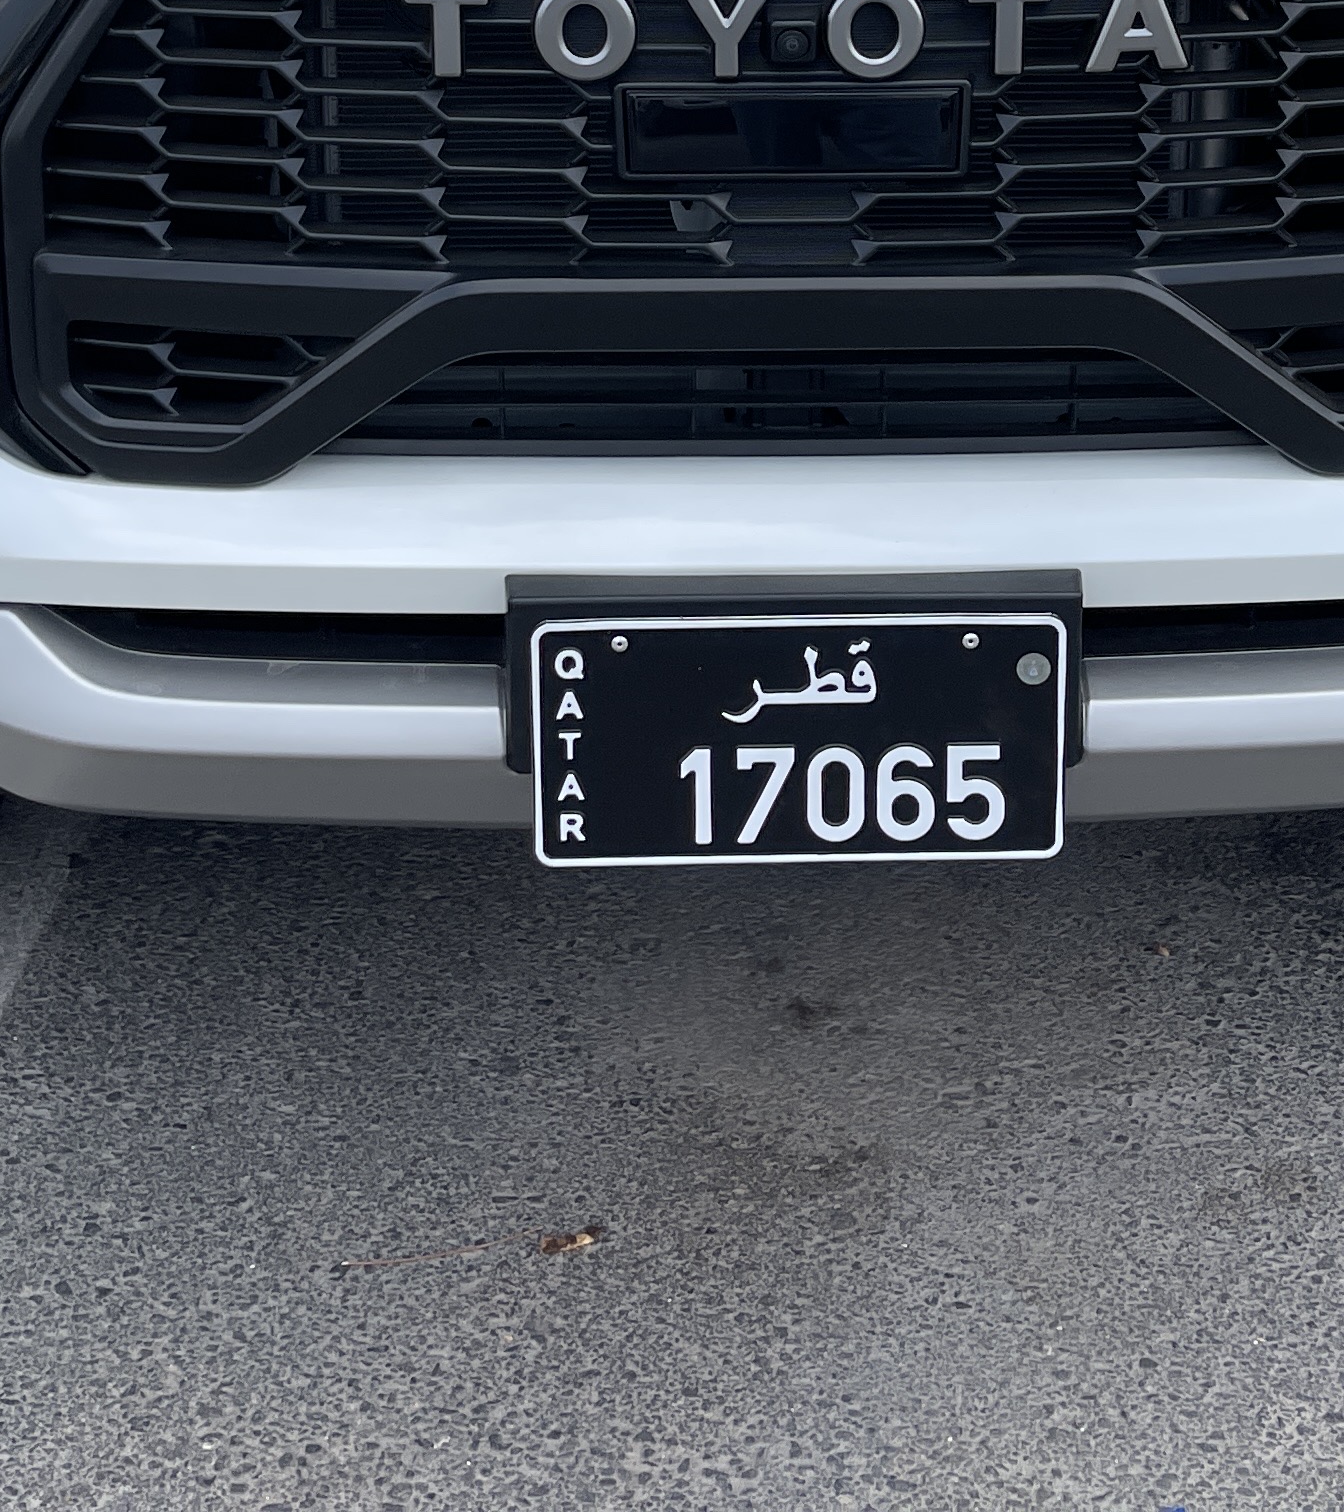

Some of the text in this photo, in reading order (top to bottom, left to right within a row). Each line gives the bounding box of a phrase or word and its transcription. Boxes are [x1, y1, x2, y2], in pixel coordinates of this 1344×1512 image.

[721, 638, 878, 724] قطر
[555, 649, 586, 843] QATAR
[679, 743, 1006, 845] 17065
